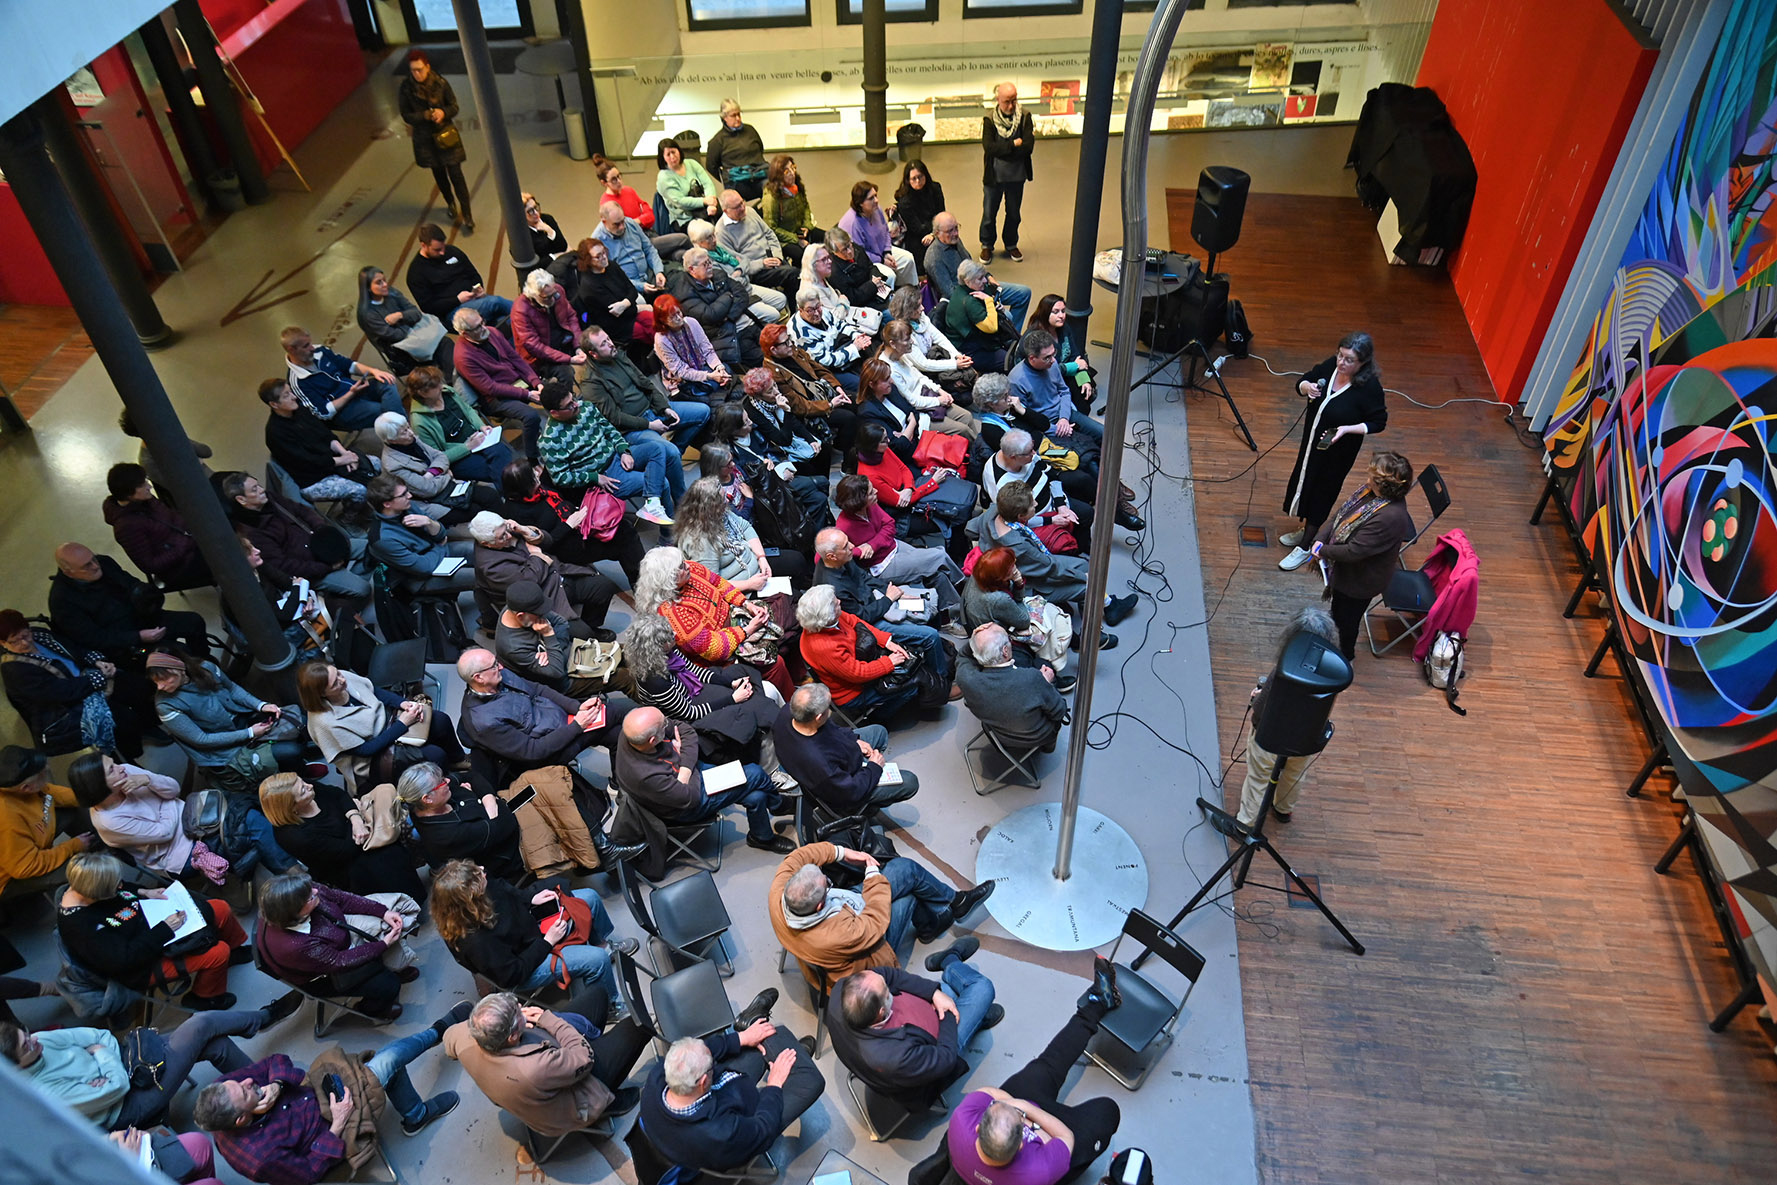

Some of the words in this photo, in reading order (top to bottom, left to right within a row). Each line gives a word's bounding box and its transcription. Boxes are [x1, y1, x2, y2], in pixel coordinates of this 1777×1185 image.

[687, 74, 700, 83] del
[771, 71, 793, 79] veure
[795, 69, 819, 78] belles
[850, 67, 860, 75] ab
[919, 63, 954, 73] melodia,
[956, 62, 967, 71] ab
[969, 61, 977, 70] lo
[979, 62, 993, 70] nas
[995, 60, 1018, 69] sentir
[1020, 58, 1043, 68] odors
[1045, 58, 1080, 69] plasents,
[1183, 52, 1194, 61] ab
[1196, 51, 1204, 60] lo
[1299, 46, 1323, 55] dures,
[1324, 44, 1348, 56] aspres
[1015, 910, 1032, 929] GREGAL
[1066, 904, 1080, 943] TRAMUNTANA
